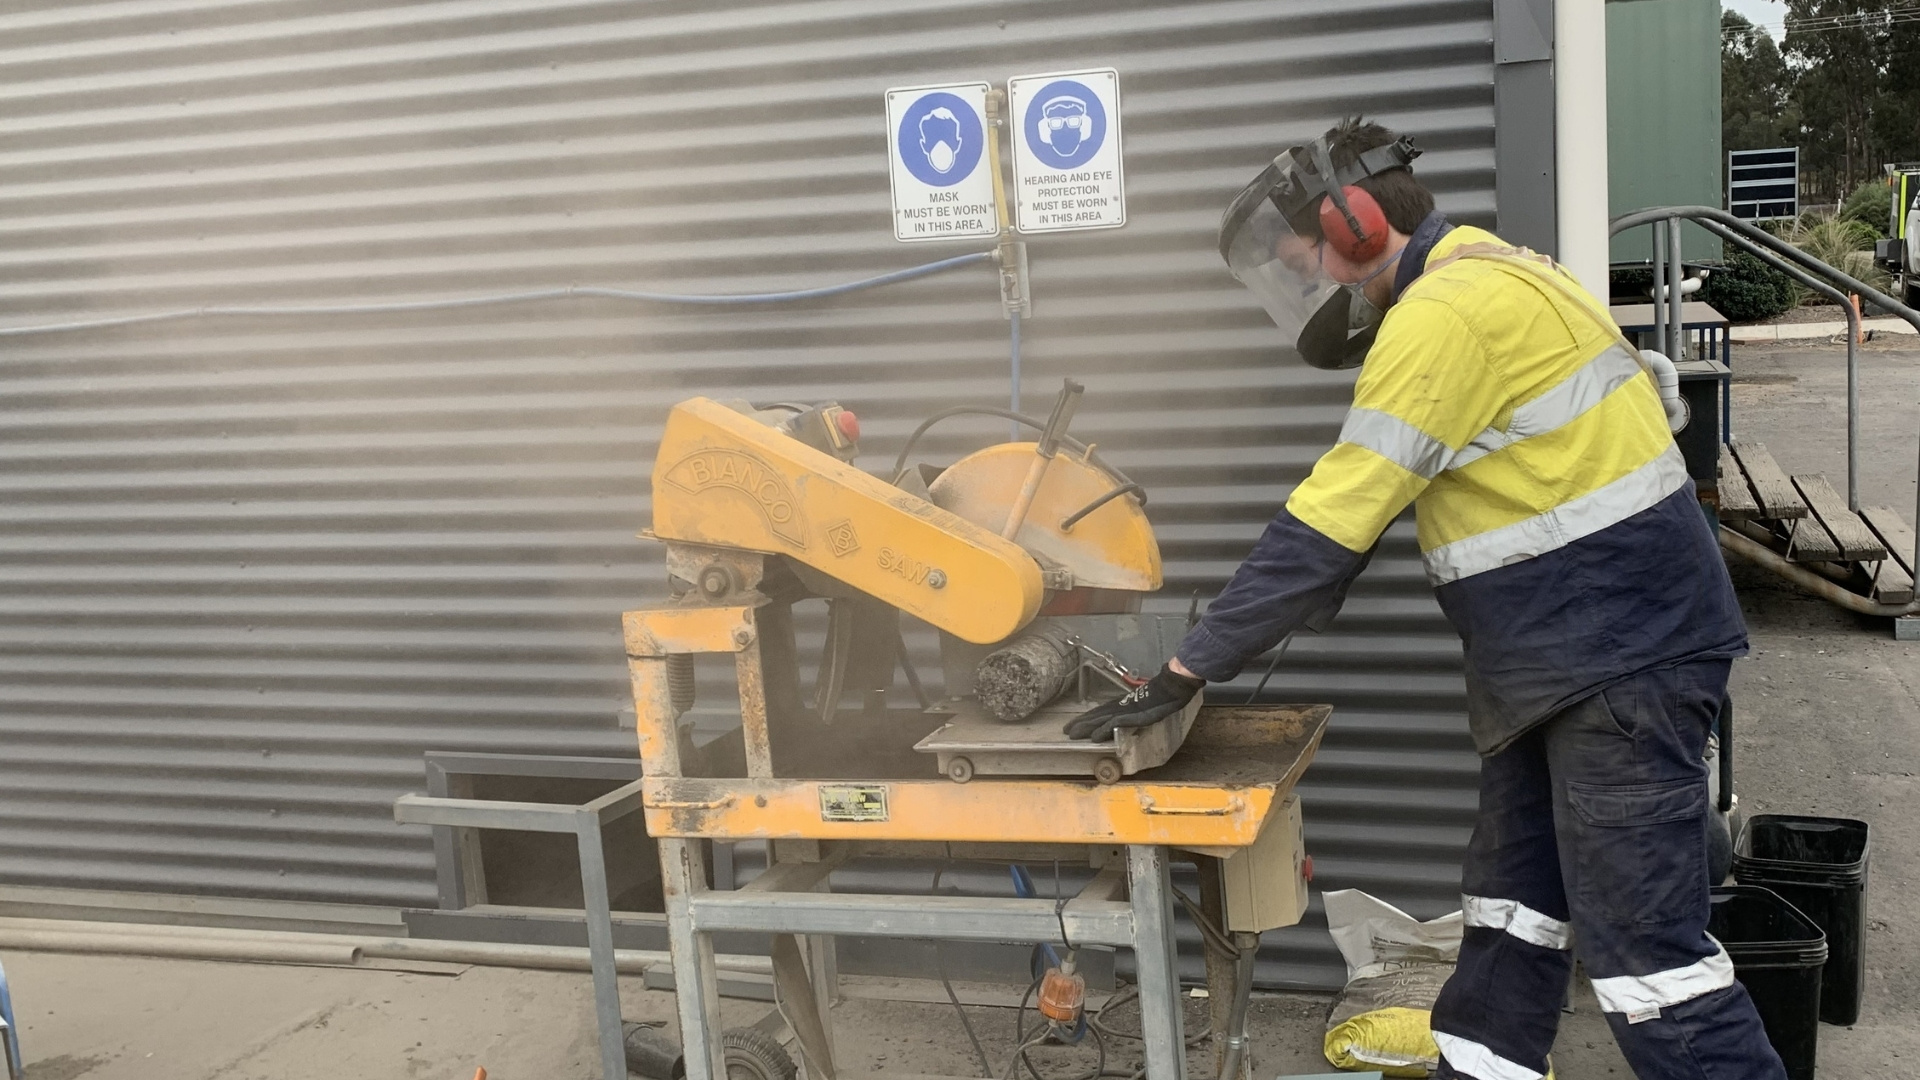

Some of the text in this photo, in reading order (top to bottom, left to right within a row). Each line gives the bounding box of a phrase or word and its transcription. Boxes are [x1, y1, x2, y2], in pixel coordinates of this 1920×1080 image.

[1025, 170, 1112, 186] HEARING AND EYE
[929, 191, 959, 203] MASK
[1038, 185, 1100, 197] PROTECTION
[1032, 197, 1107, 211] MUST BE WORN
[904, 204, 987, 219] MUST BE WORN
[1039, 211, 1102, 224] IN THIS AREA
[914, 219, 983, 233] IN THIS AREA
[689, 455, 792, 523] BIANCO
[834, 525, 852, 551] B
[877, 546, 931, 585] SAW
